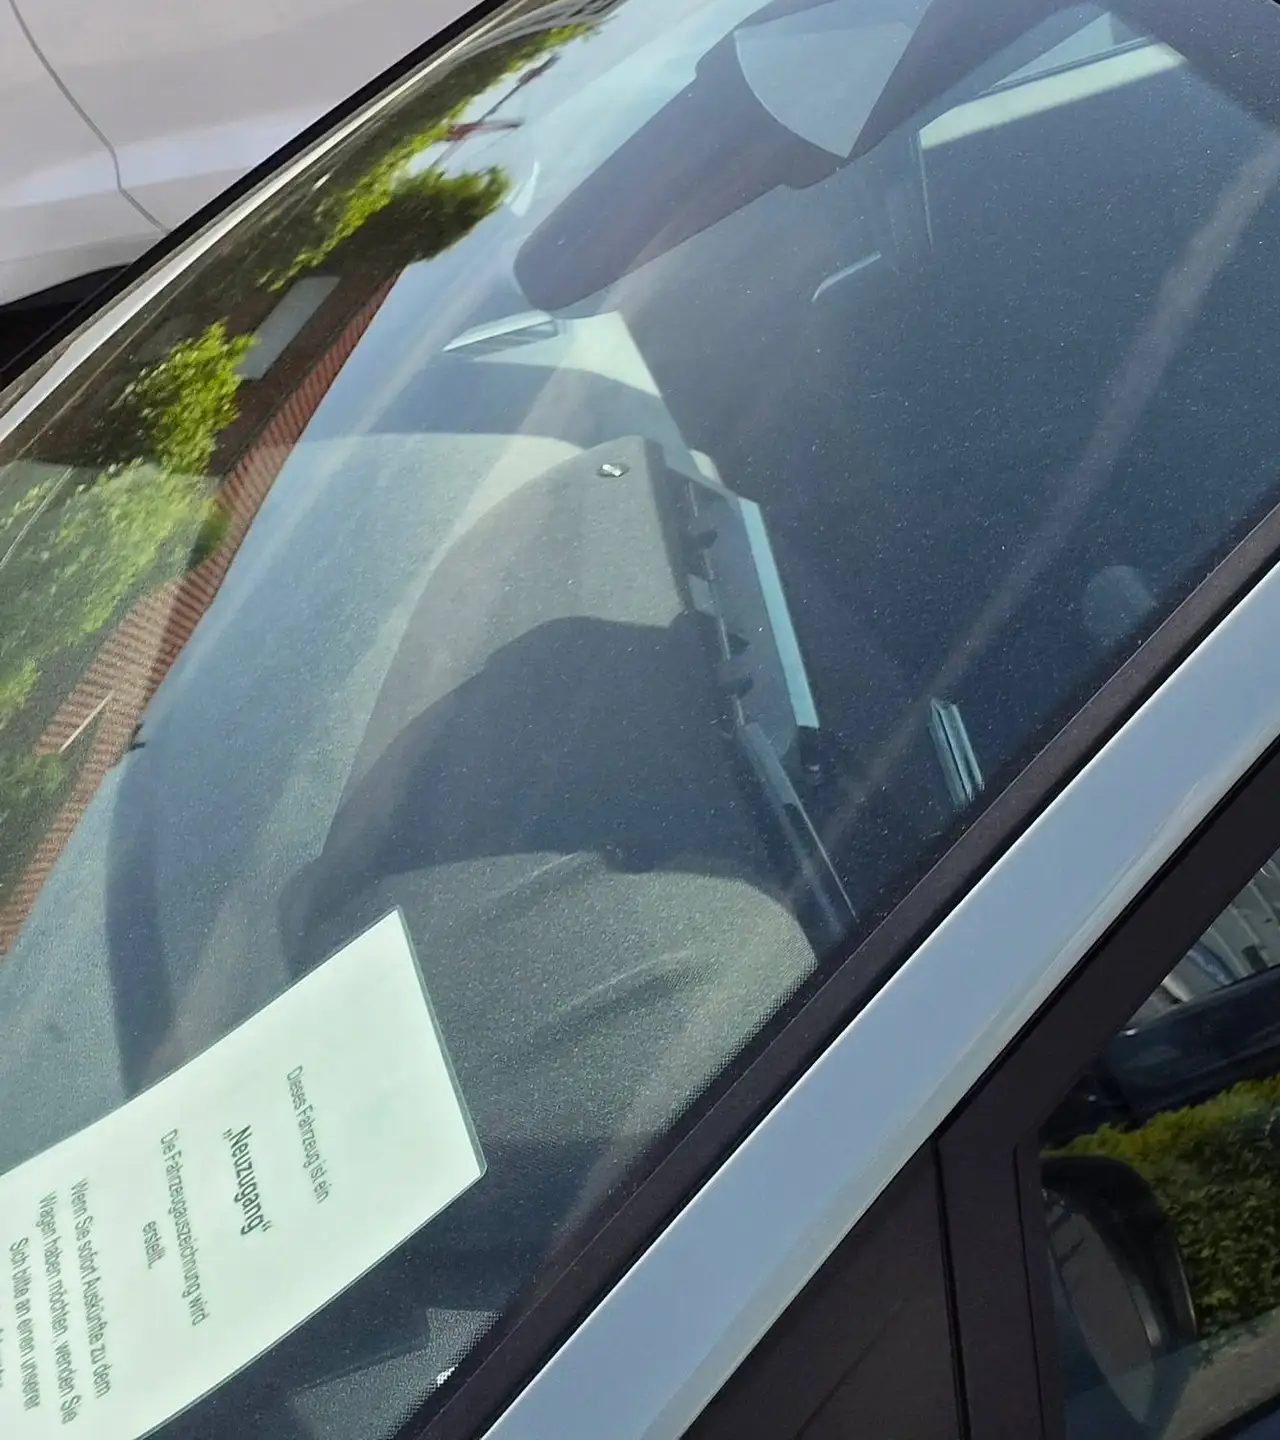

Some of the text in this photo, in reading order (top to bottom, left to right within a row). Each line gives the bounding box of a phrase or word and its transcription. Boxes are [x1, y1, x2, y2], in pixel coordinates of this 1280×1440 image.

[286, 1064, 333, 1205] Dieses Fahrzeug ist ein
[35, 1191, 58, 1241] Wagen
[142, 1220, 166, 1270] erstellt.
[160, 1128, 210, 1326] Die Fahrzeugauszeichnung wird
[44, 1235, 63, 1281] haben
[71, 1177, 113, 1399] Wenn Sie sofort Auskünfte zu dem
[8, 1237, 41, 1412] Sich bitte an einen unserer
[54, 1340, 79, 1399] wenden
[60, 1394, 83, 1426] Sie
